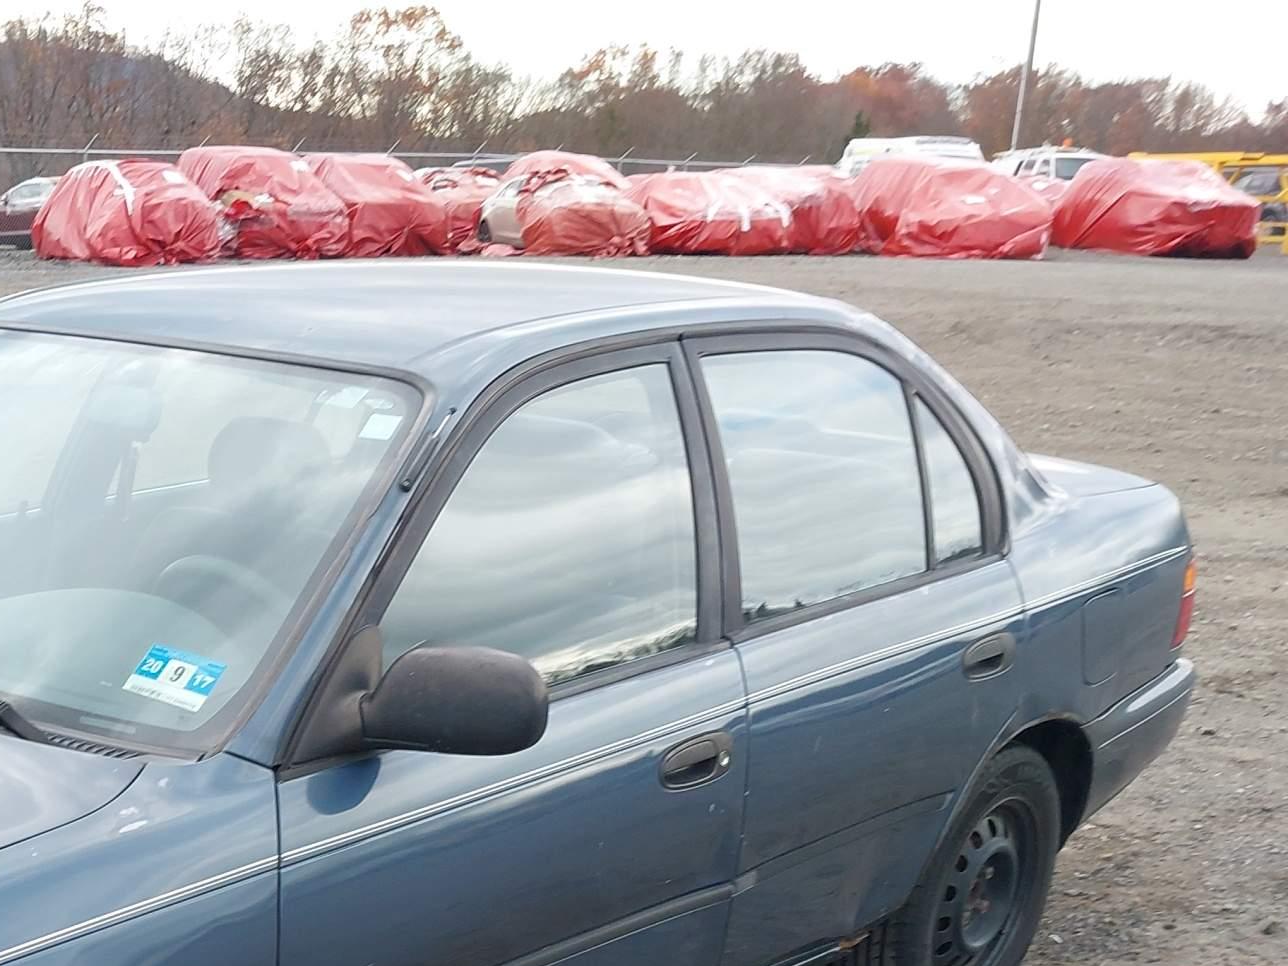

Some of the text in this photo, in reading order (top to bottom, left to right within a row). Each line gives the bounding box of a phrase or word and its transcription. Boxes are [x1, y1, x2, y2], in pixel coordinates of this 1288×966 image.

[140, 658, 216, 689] 20 9 17
